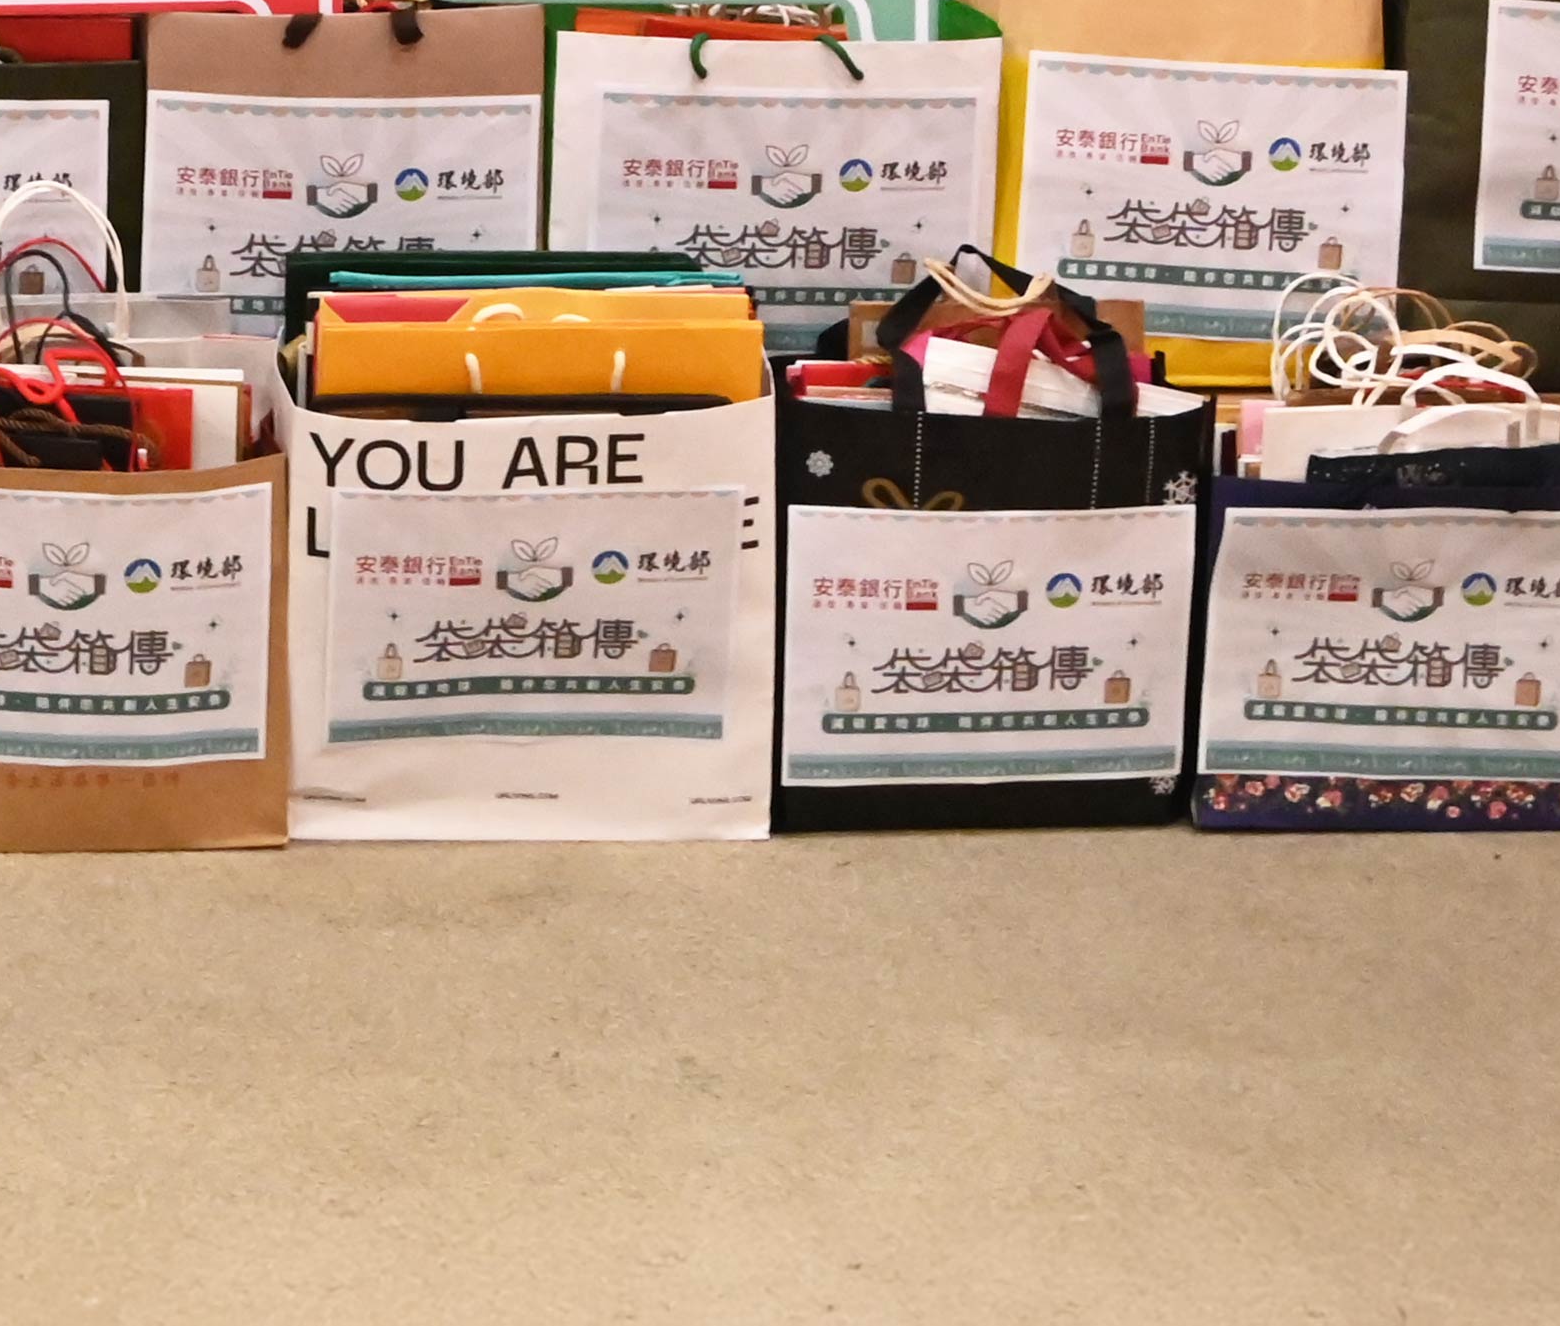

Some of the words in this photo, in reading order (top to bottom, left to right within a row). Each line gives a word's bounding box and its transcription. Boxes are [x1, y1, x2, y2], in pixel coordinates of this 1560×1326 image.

[309, 431, 464, 491] YOU
[501, 433, 646, 490] ARE
[356, 555, 448, 576] 安泰銀行
